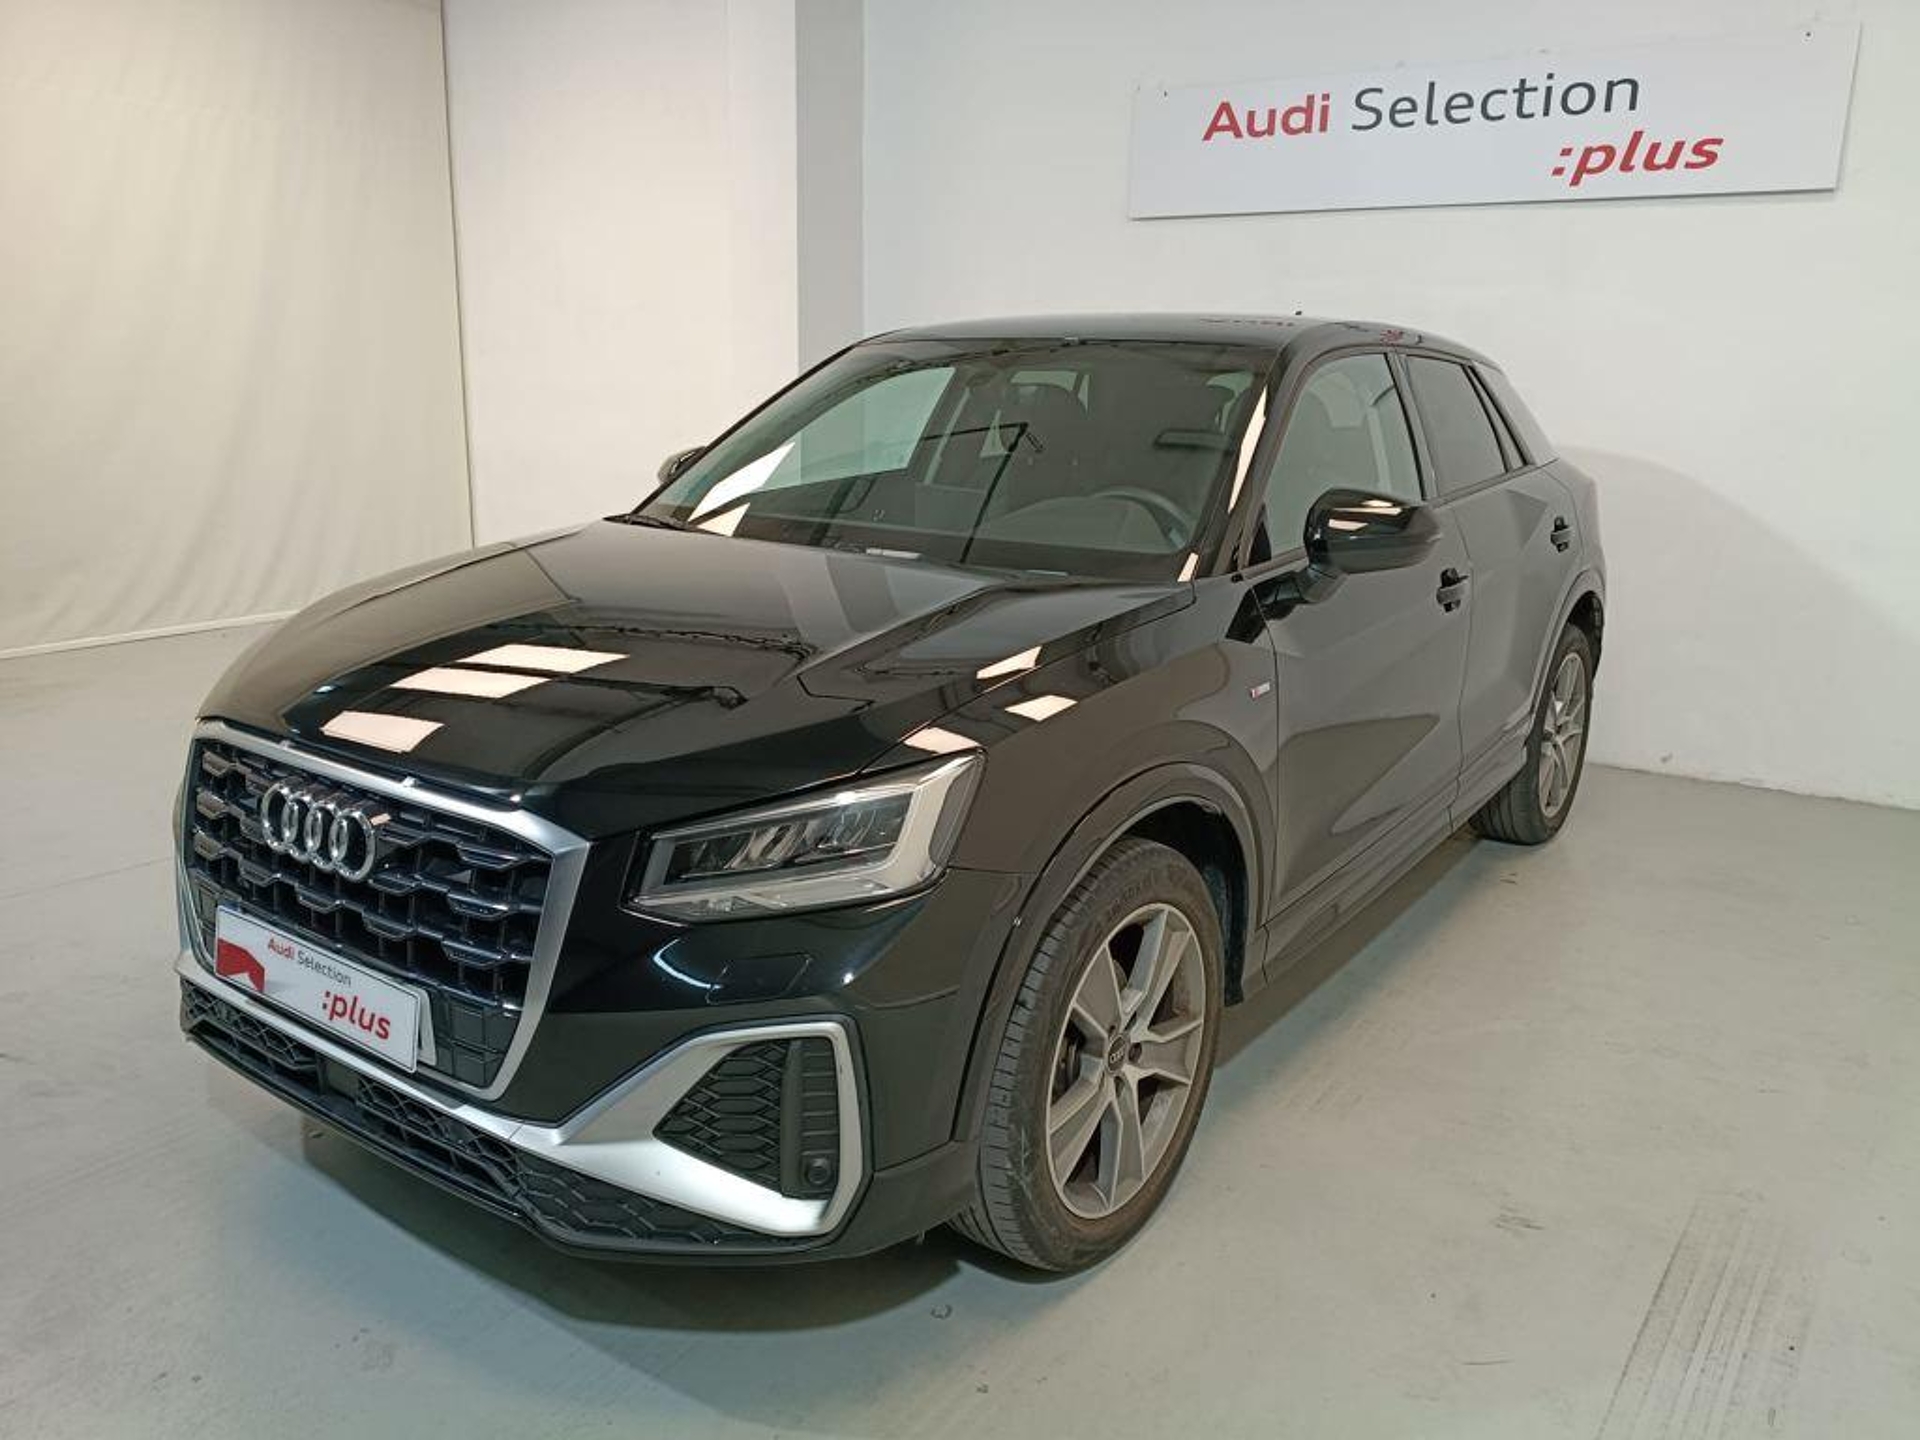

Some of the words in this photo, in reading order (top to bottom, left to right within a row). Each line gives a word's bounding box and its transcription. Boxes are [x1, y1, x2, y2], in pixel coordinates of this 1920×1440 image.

[1203, 94, 1330, 142] Audi
[1351, 73, 1641, 131] Selection
[1551, 131, 1724, 186] :plus
[268, 939, 295, 960] Audi
[297, 950, 352, 985] Selection
[322, 990, 391, 1040] :plus
